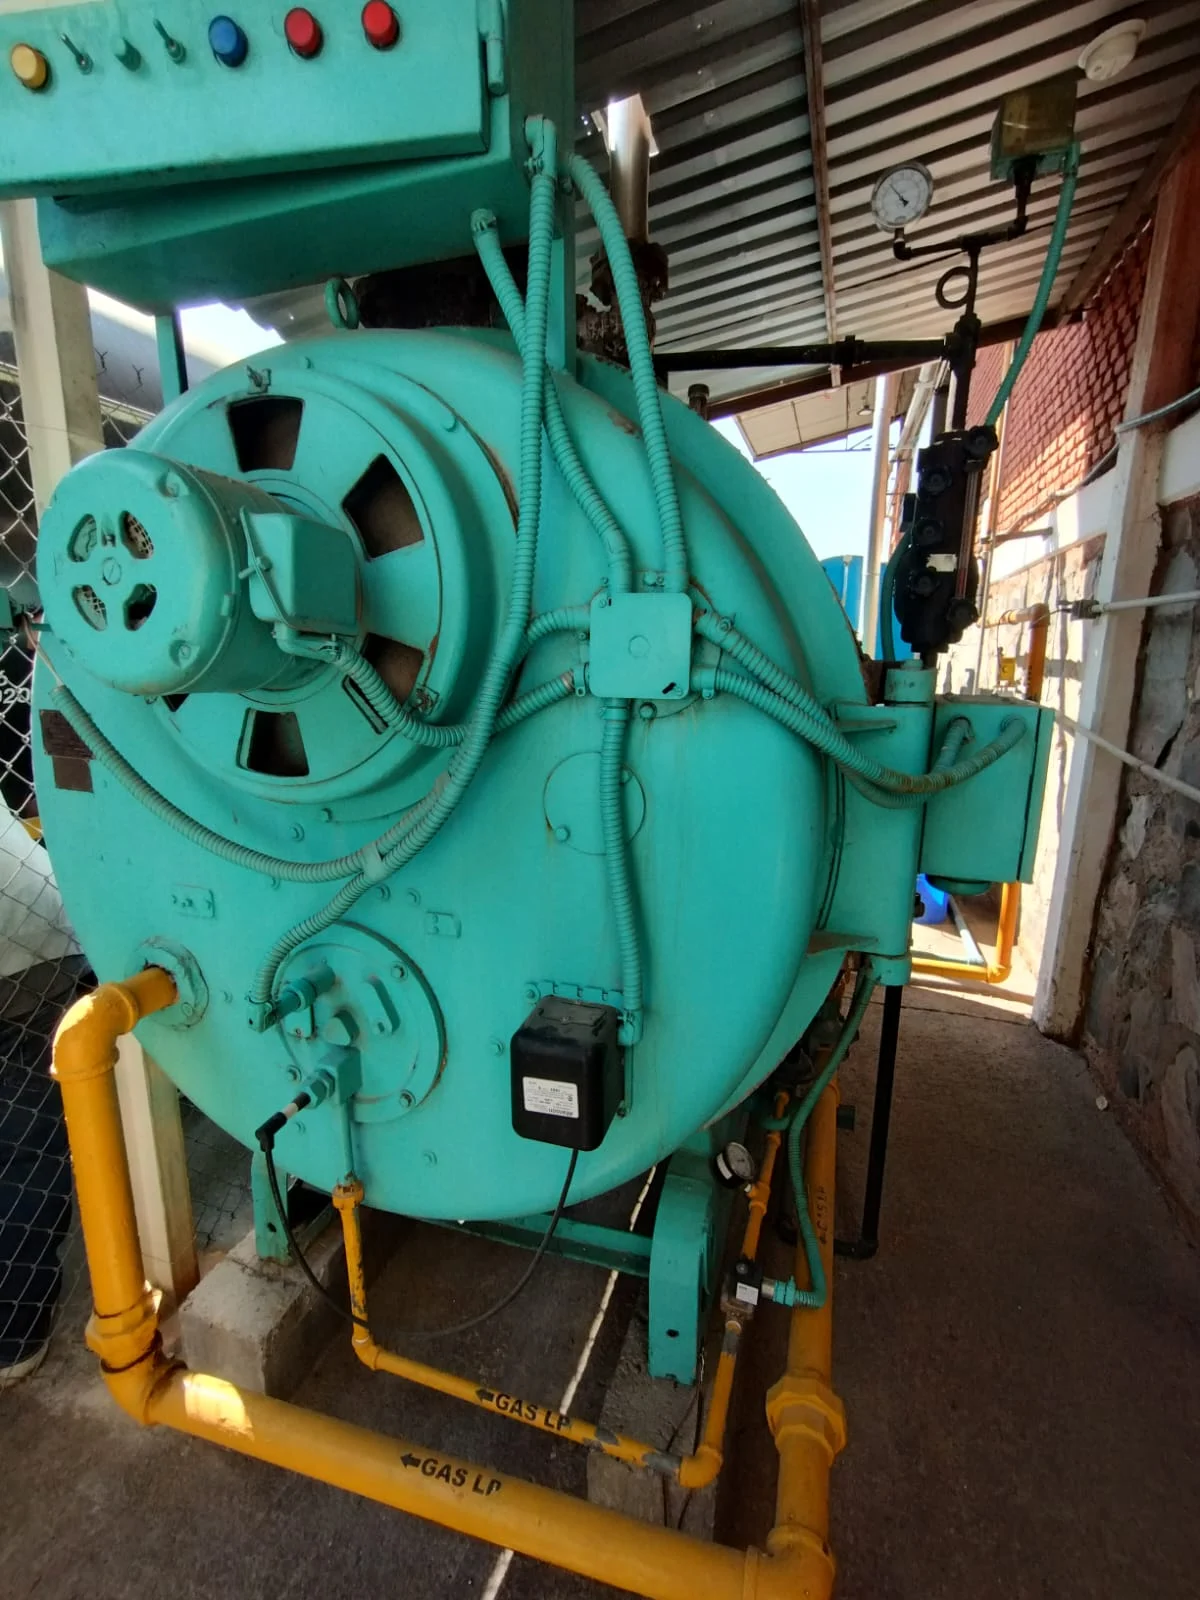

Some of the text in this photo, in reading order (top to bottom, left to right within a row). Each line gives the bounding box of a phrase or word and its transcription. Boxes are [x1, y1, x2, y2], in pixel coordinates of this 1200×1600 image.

[0, 687, 31, 704] 20
[496, 1393, 570, 1431] GAS LP
[421, 1458, 502, 1496] GAS LP
